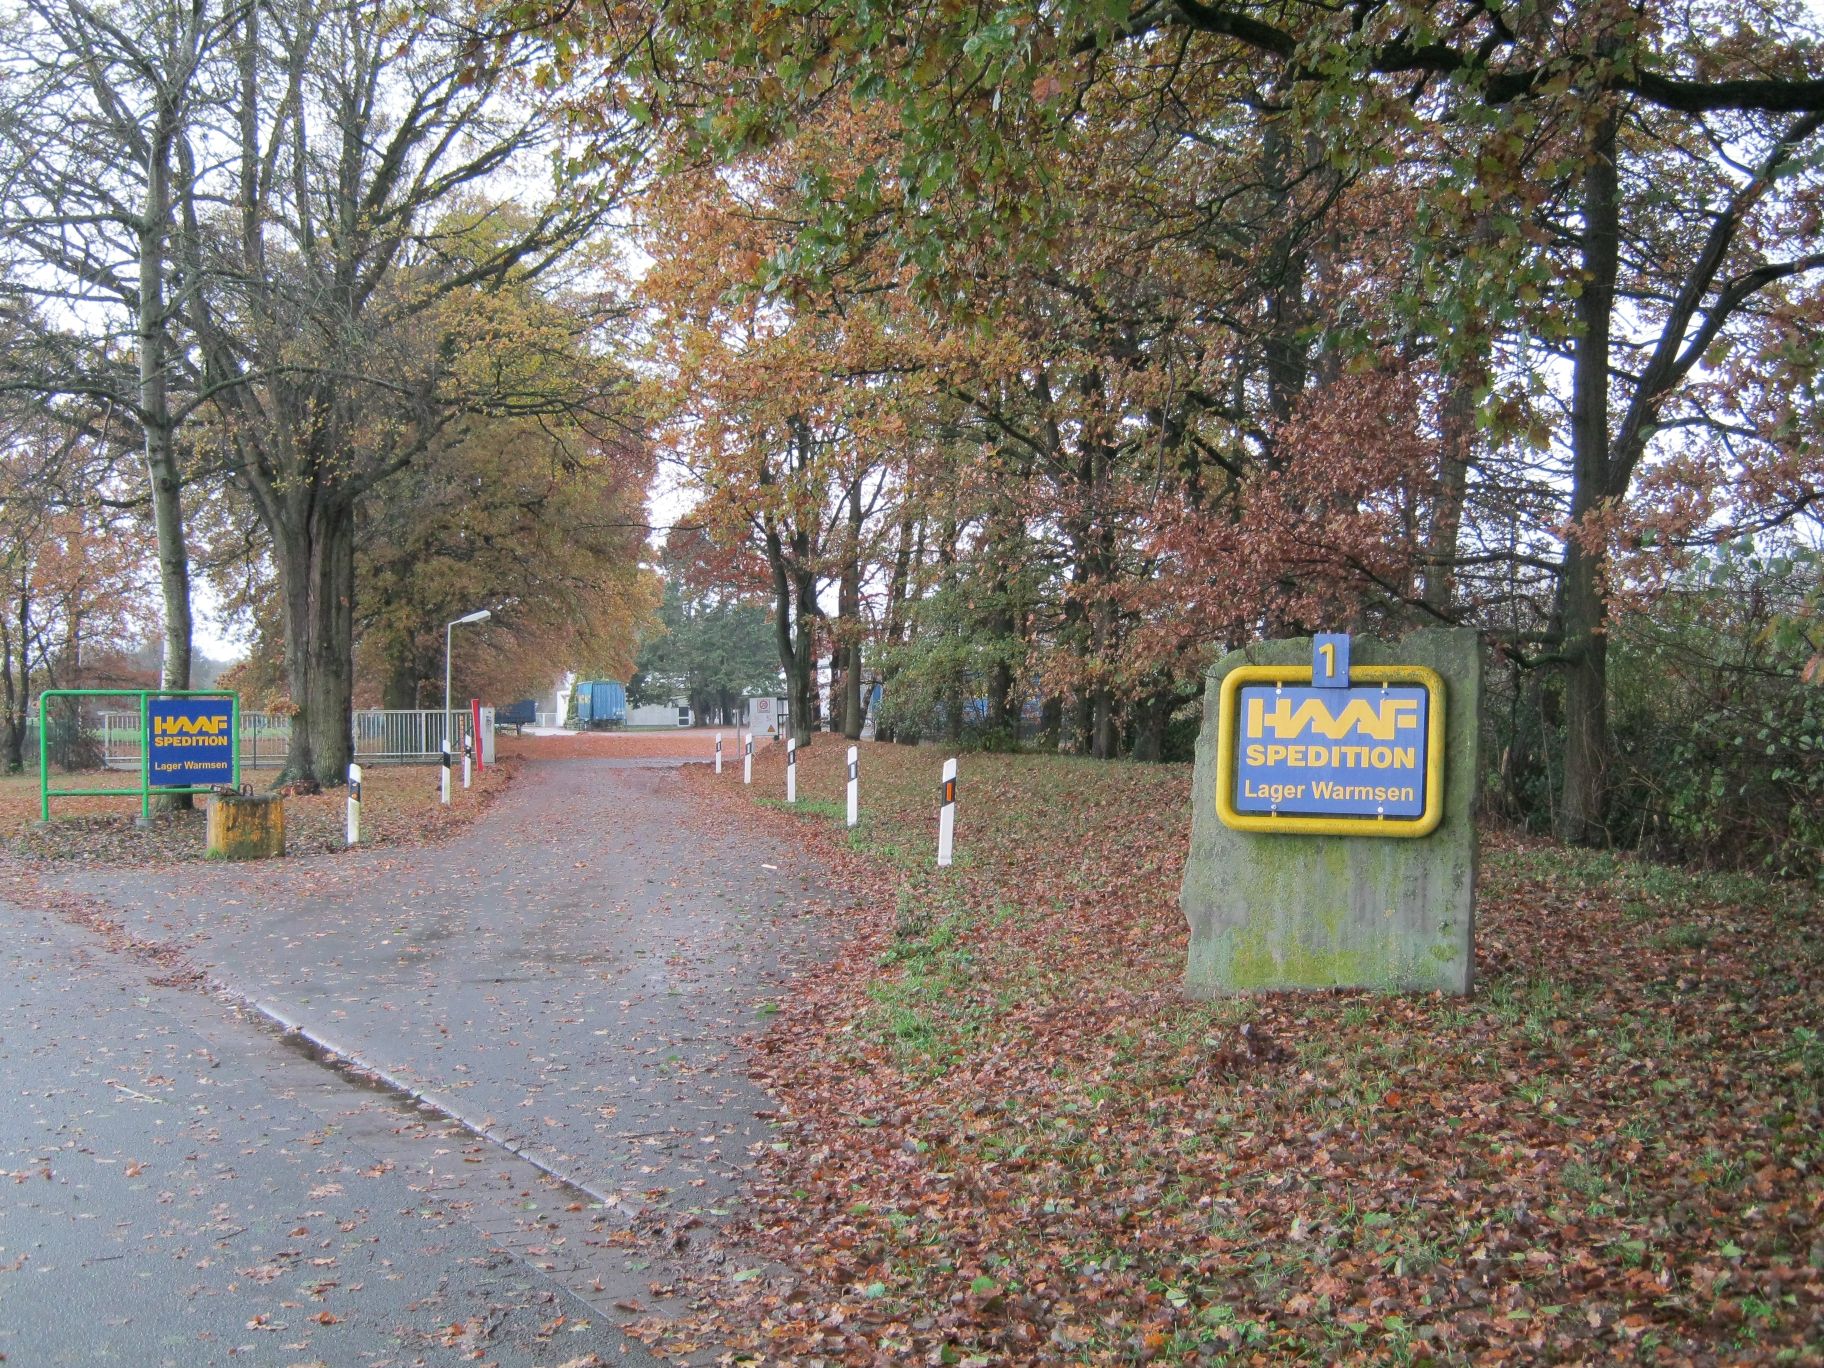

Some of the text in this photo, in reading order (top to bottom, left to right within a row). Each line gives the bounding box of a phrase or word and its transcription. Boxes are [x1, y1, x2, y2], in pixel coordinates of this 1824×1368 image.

[1319, 643, 1334, 677] 1
[154, 716, 228, 734] HAAF
[1247, 698, 1418, 740] HAAF
[154, 736, 228, 747] SPEDITION
[154, 761, 228, 772] Lager Warmsen
[1246, 745, 1415, 768] SPEDITION
[1245, 779, 1414, 802] Lager Warmsen
